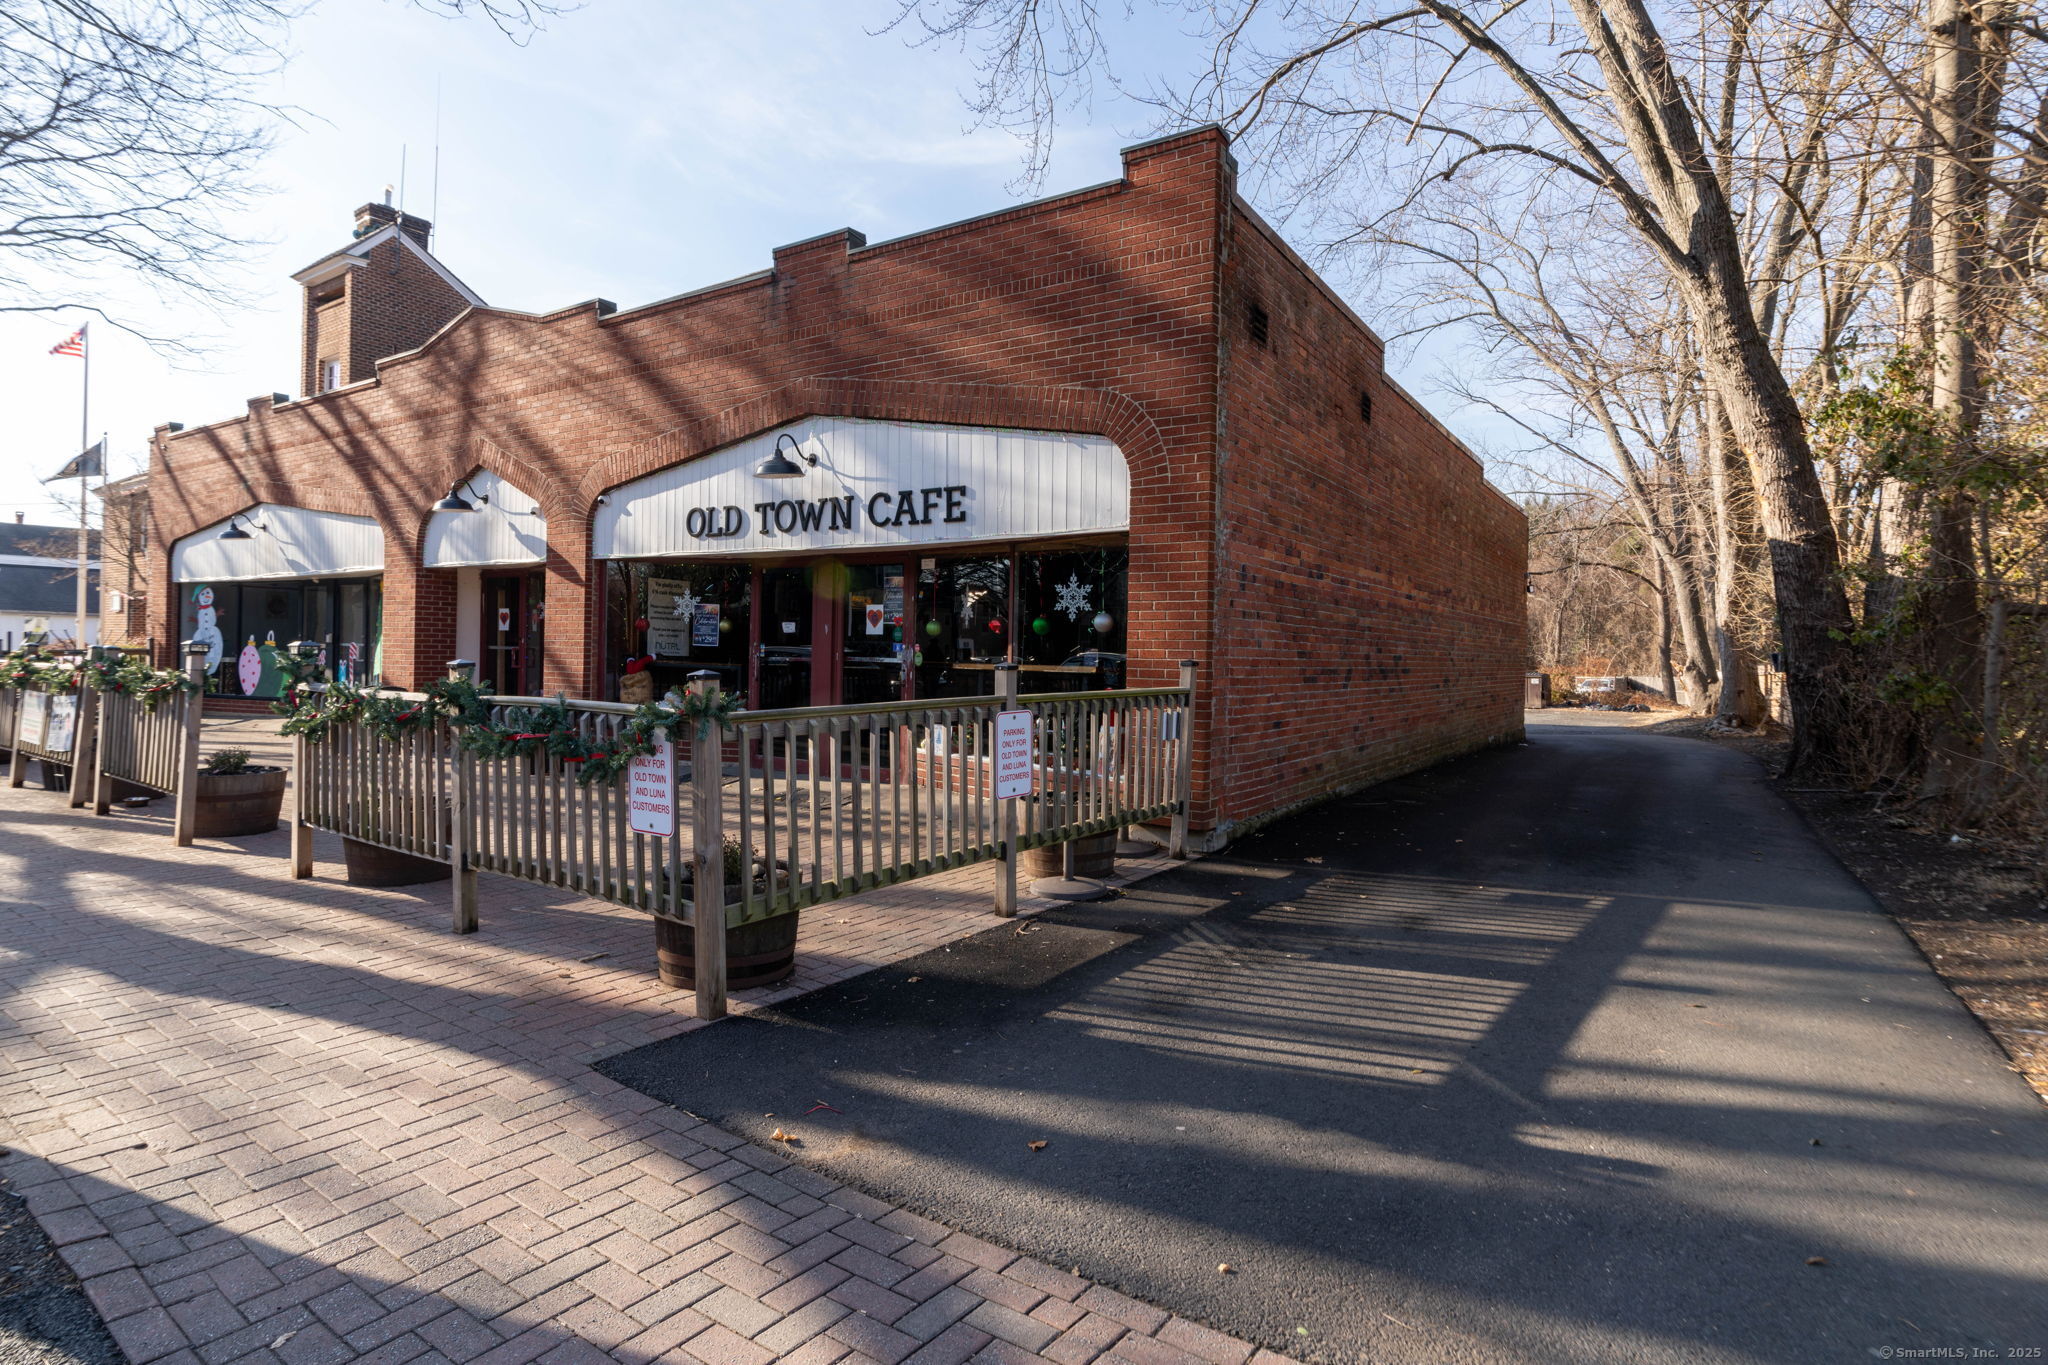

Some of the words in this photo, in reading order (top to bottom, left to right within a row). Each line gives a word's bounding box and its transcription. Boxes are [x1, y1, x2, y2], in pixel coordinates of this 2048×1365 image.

[686, 506, 743, 538] OLD
[754, 495, 855, 535] TOWN
[868, 485, 967, 528] CAFE
[1003, 728, 1025, 736] PARKING
[1002, 740, 1015, 748] ONLY
[1001, 752, 1011, 760] OLD
[1012, 750, 1027, 758] TOWN
[635, 757, 652, 767] ONLY
[652, 759, 665, 768] FOR
[1013, 761, 1026, 769] LUNA
[634, 772, 647, 782] OLD
[648, 773, 666, 784] TOWN
[999, 771, 1029, 783] CUSTOMERS
[636, 786, 648, 796] AND
[649, 788, 665, 798] LUNA
[632, 801, 670, 814] CUSTOMERS
